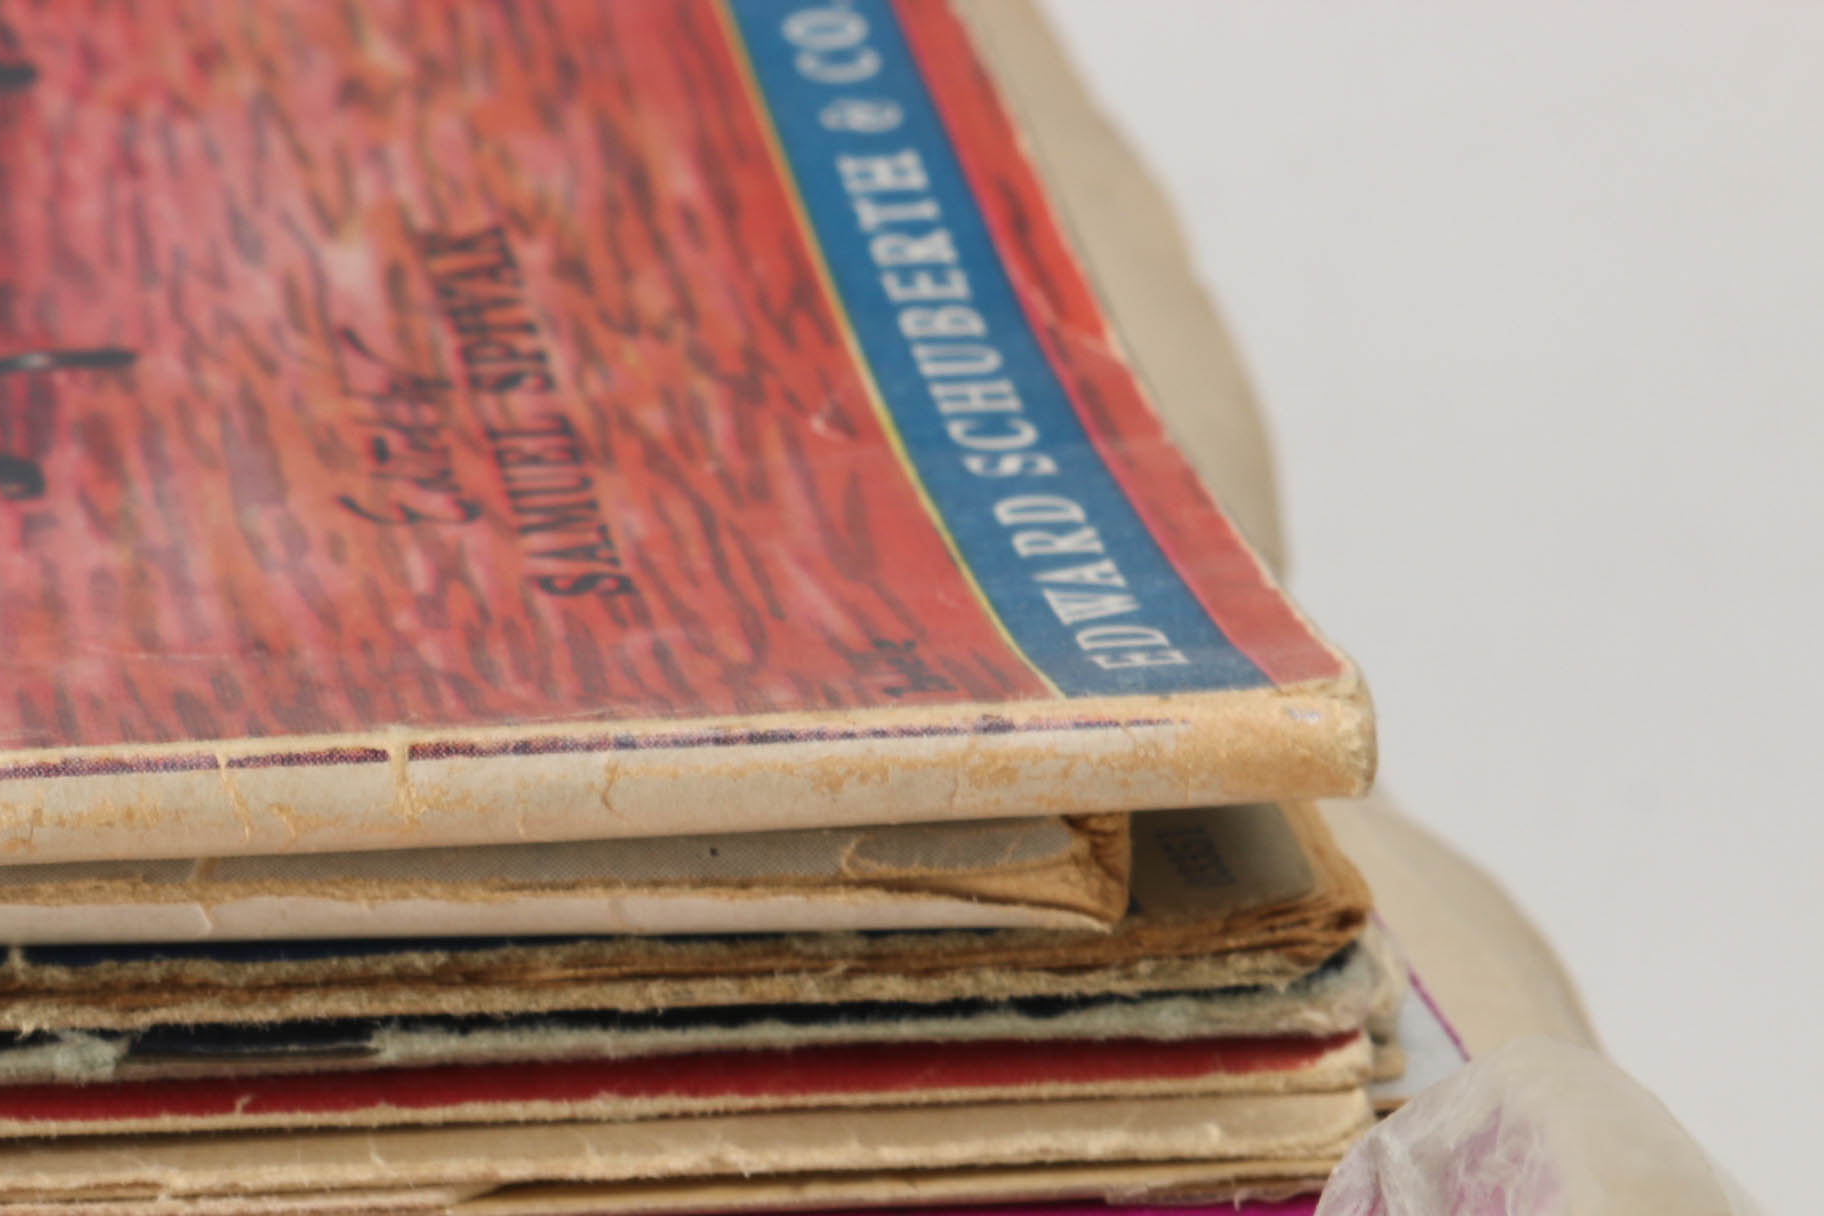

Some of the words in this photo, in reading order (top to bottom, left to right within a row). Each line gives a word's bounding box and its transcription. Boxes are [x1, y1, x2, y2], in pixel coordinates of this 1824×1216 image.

[834, 147, 1059, 478] SCHUBERTH
[485, 414, 638, 597] SAMUEL
[991, 493, 1190, 671] EDWARD
